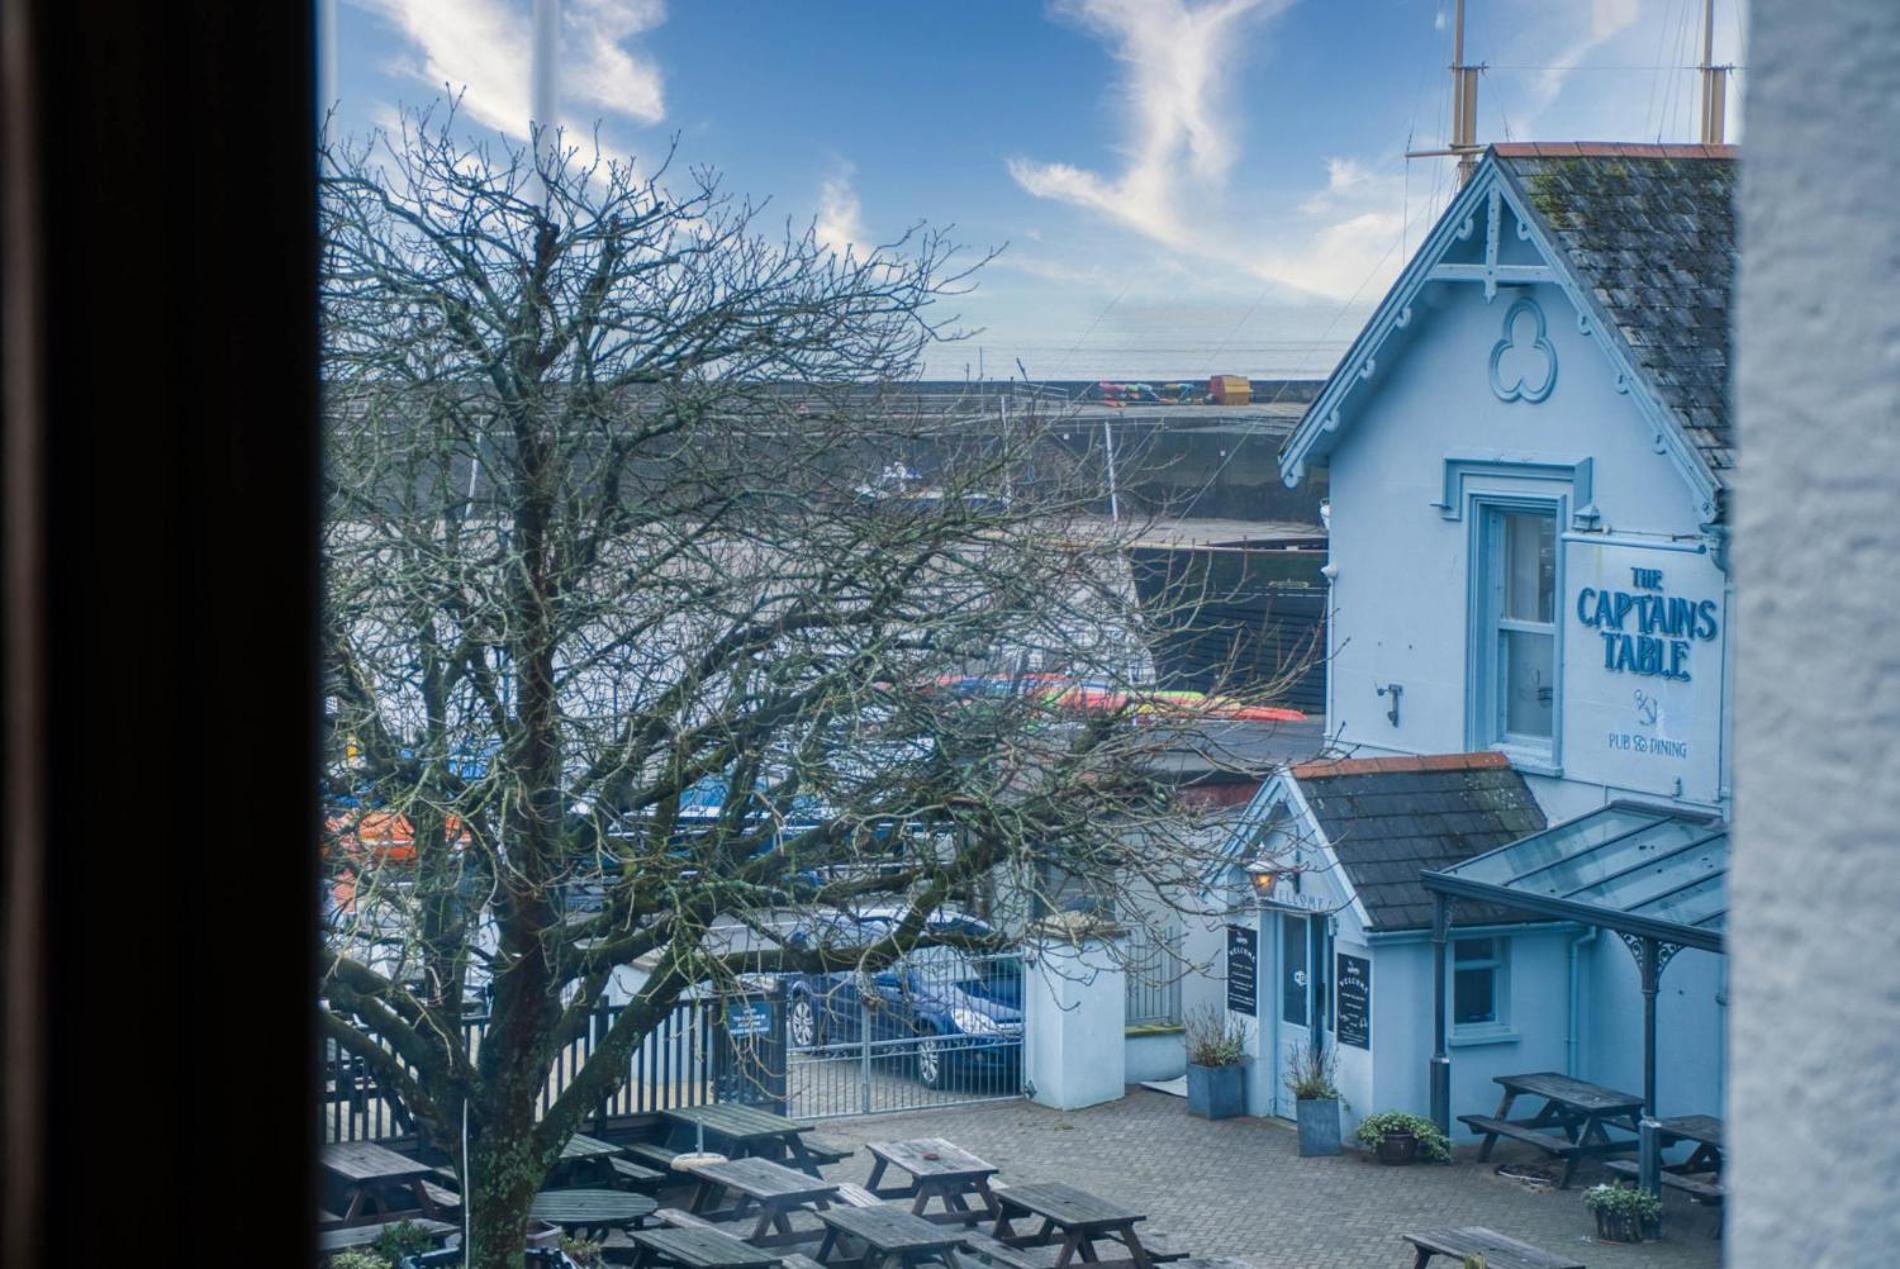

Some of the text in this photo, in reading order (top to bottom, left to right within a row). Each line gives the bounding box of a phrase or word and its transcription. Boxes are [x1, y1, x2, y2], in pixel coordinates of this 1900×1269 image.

[1631, 567, 1664, 591] THE
[1577, 587, 1717, 642] CAPTAINS
[1600, 631, 1692, 682] TABLE
[1609, 733, 1630, 751] PUB
[1650, 739, 1687, 759] DINING
